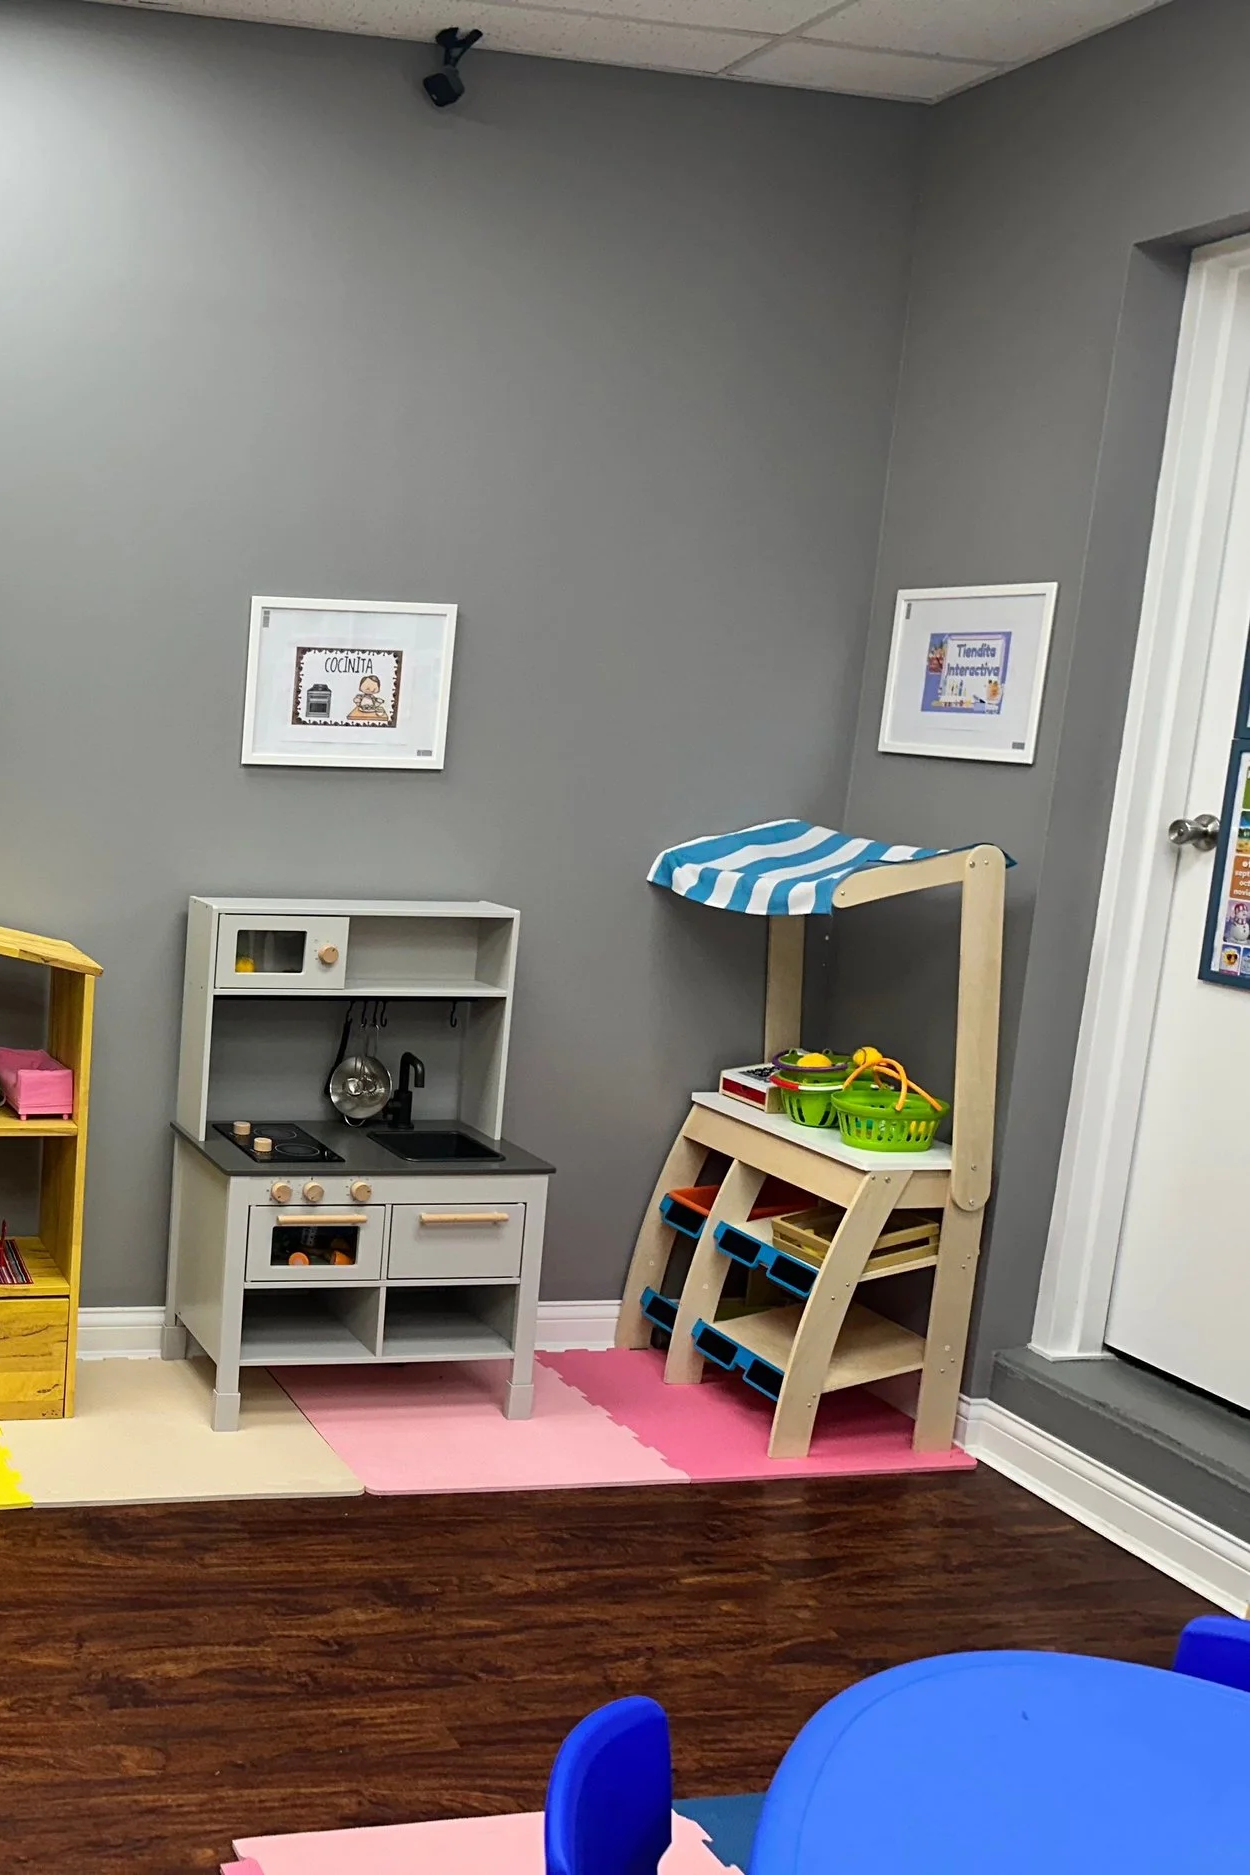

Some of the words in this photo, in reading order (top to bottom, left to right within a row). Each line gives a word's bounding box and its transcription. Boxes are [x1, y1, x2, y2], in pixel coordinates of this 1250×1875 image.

[956, 643, 997, 658] Tiendita
[324, 655, 374, 675] COCINITA
[946, 661, 1000, 677] Interactiva
